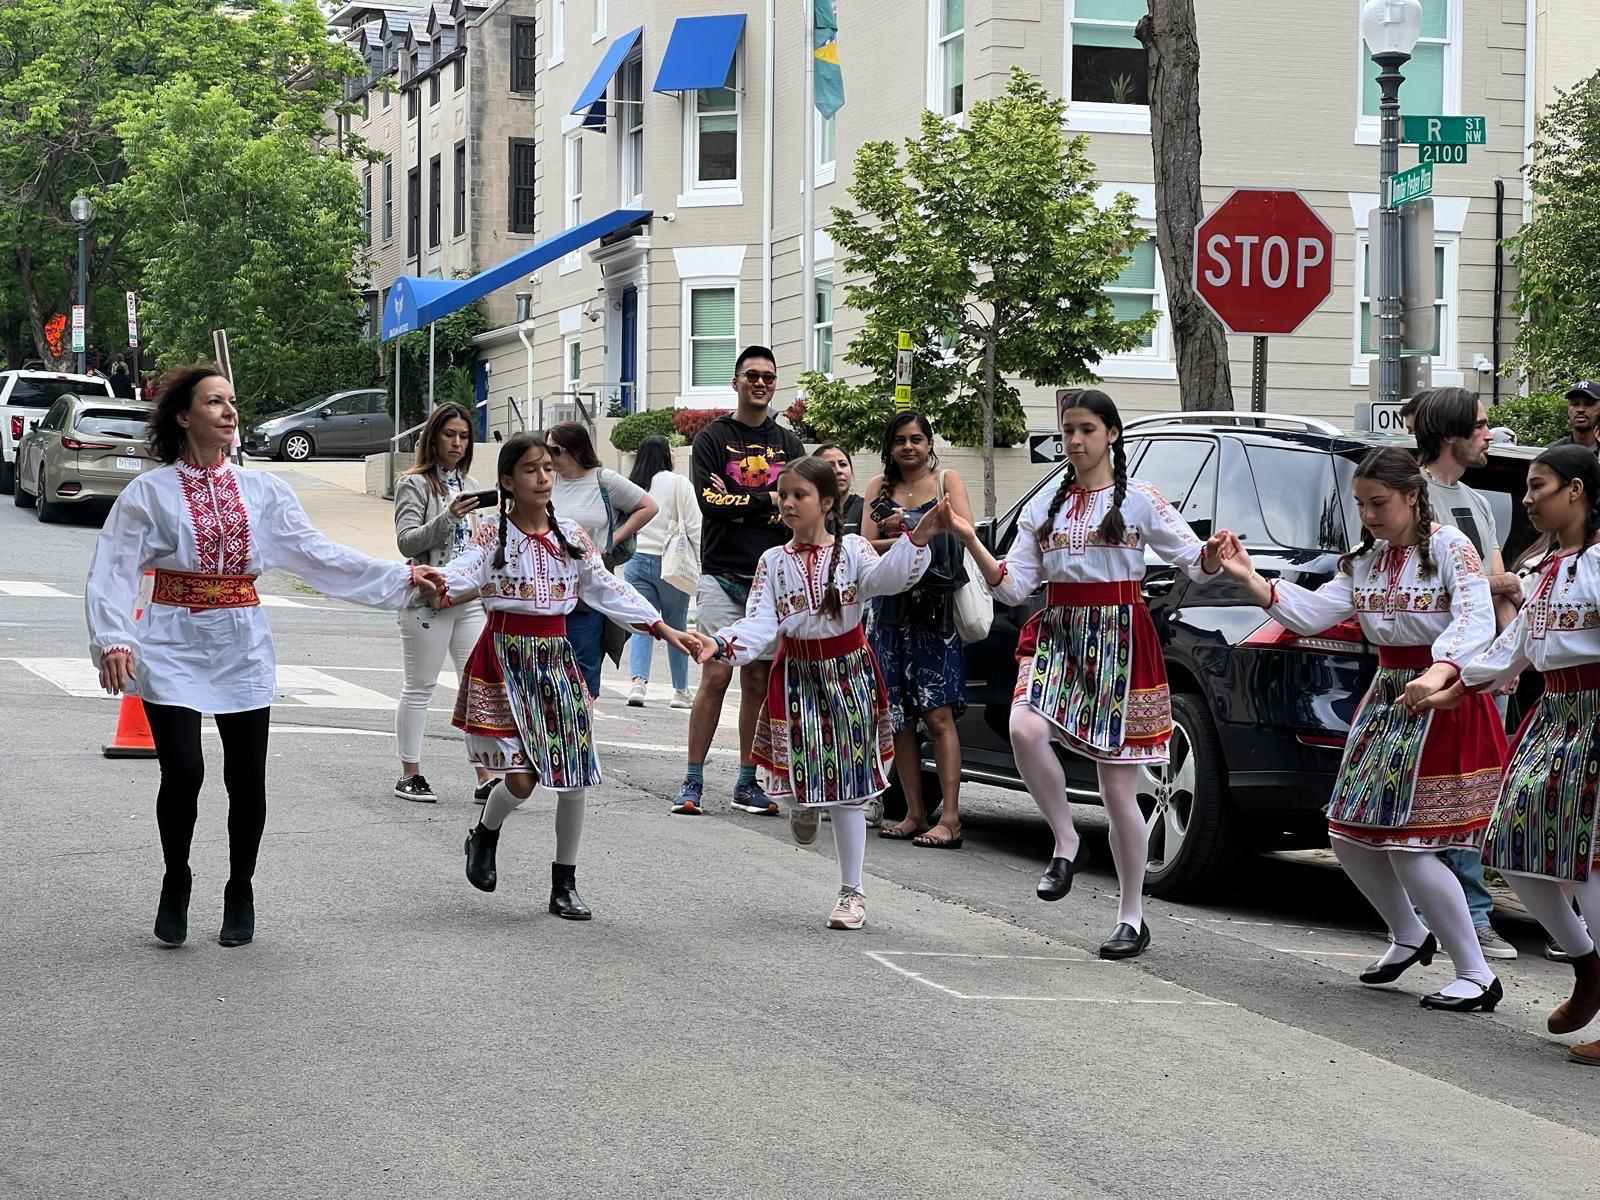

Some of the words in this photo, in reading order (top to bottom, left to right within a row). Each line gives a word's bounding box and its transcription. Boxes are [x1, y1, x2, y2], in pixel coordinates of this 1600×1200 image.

[1427, 118, 1442, 142] R
[1465, 118, 1481, 130] ST
[1465, 131, 1481, 143] NW
[1423, 145, 1463, 162] 2100
[1204, 234, 1324, 288] STOP
[1378, 410, 1404, 429] ON
